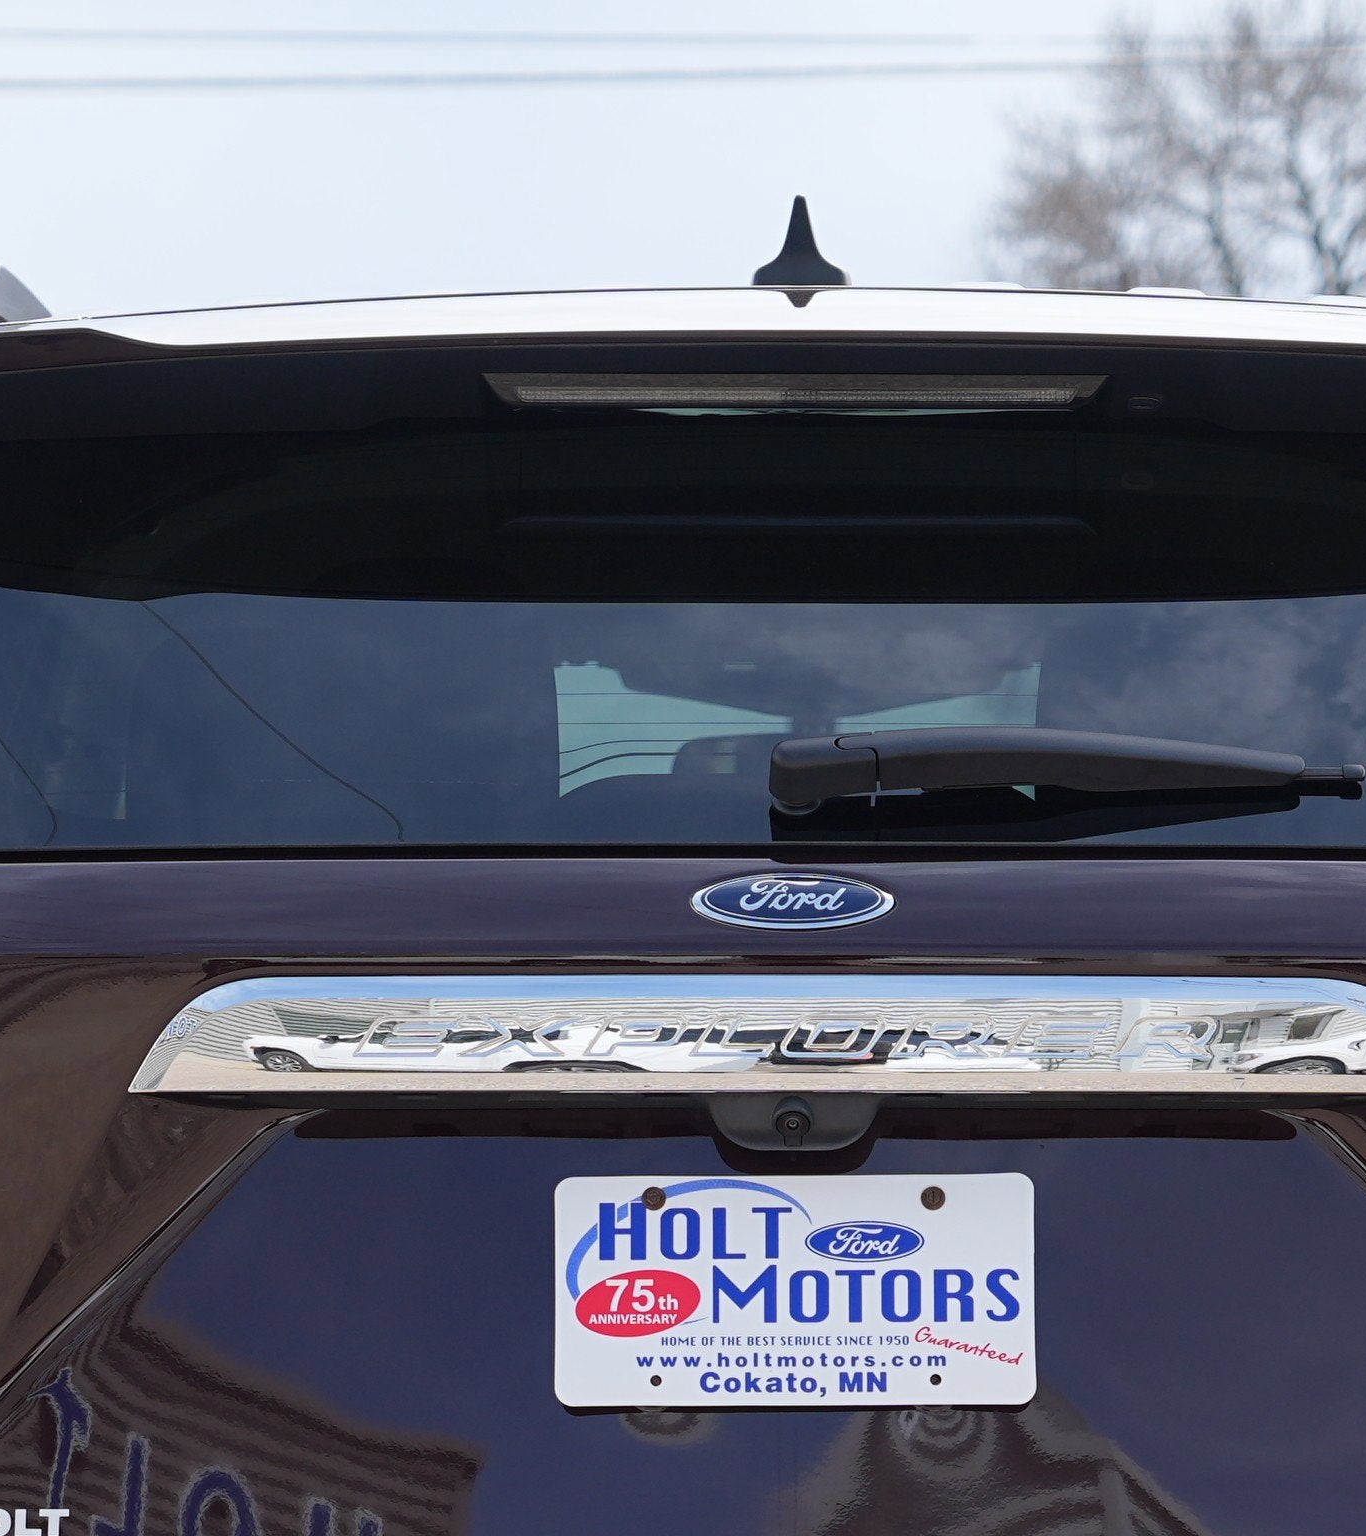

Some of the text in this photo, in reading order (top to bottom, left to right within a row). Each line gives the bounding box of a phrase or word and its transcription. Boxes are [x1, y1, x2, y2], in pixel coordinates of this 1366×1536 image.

[739, 879, 847, 911] Ford
[354, 1014, 1218, 1058] EXPLORER
[598, 1202, 901, 1260] HOLT Ford
[605, 1278, 679, 1312] 75th
[712, 1264, 1020, 1323] MOTORS
[588, 1313, 677, 1325] ANNIVERSARY
[661, 1335, 910, 1346] HOME OF THE BEST SERVICE SINCE 1950
[914, 1326, 1024, 1366] Guaranteed
[636, 1352, 947, 1367] www.holtmotors.com
[699, 1371, 888, 1397] Cokato, MN
